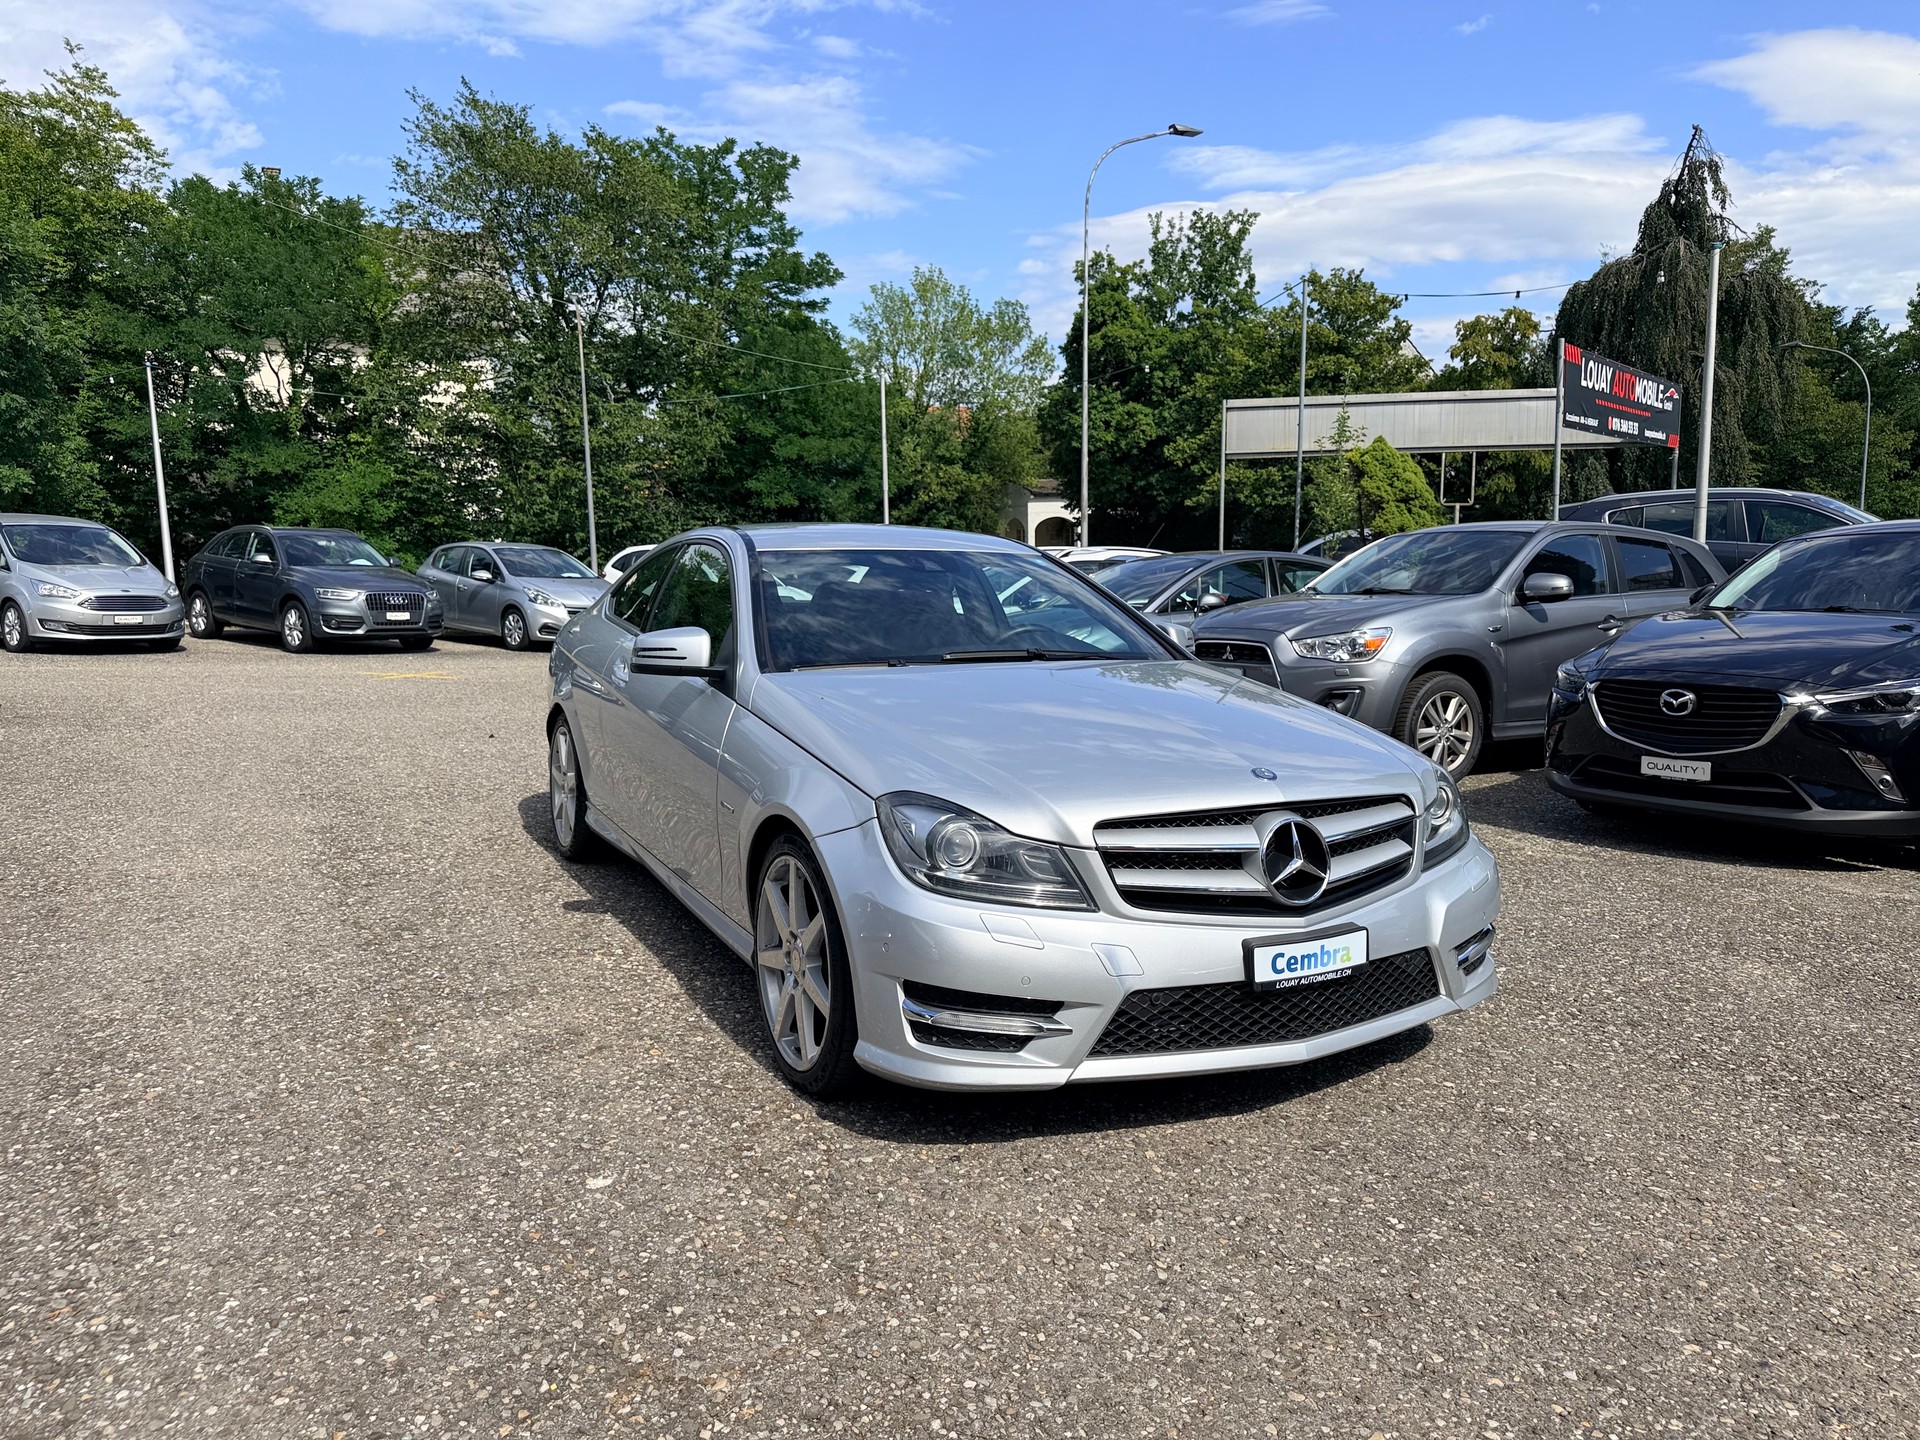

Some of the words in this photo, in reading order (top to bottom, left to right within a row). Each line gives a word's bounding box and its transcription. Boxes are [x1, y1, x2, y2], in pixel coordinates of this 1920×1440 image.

[1581, 357, 1613, 393] LOUAY
[1613, 370, 1664, 408] AUTOMOBILE
[1647, 762, 1698, 774] QUALITY
[1271, 945, 1351, 974] Cembra
[1276, 979, 1299, 988] LOUAY
[1300, 968, 1352, 985] AUTOMOBILE.CH
